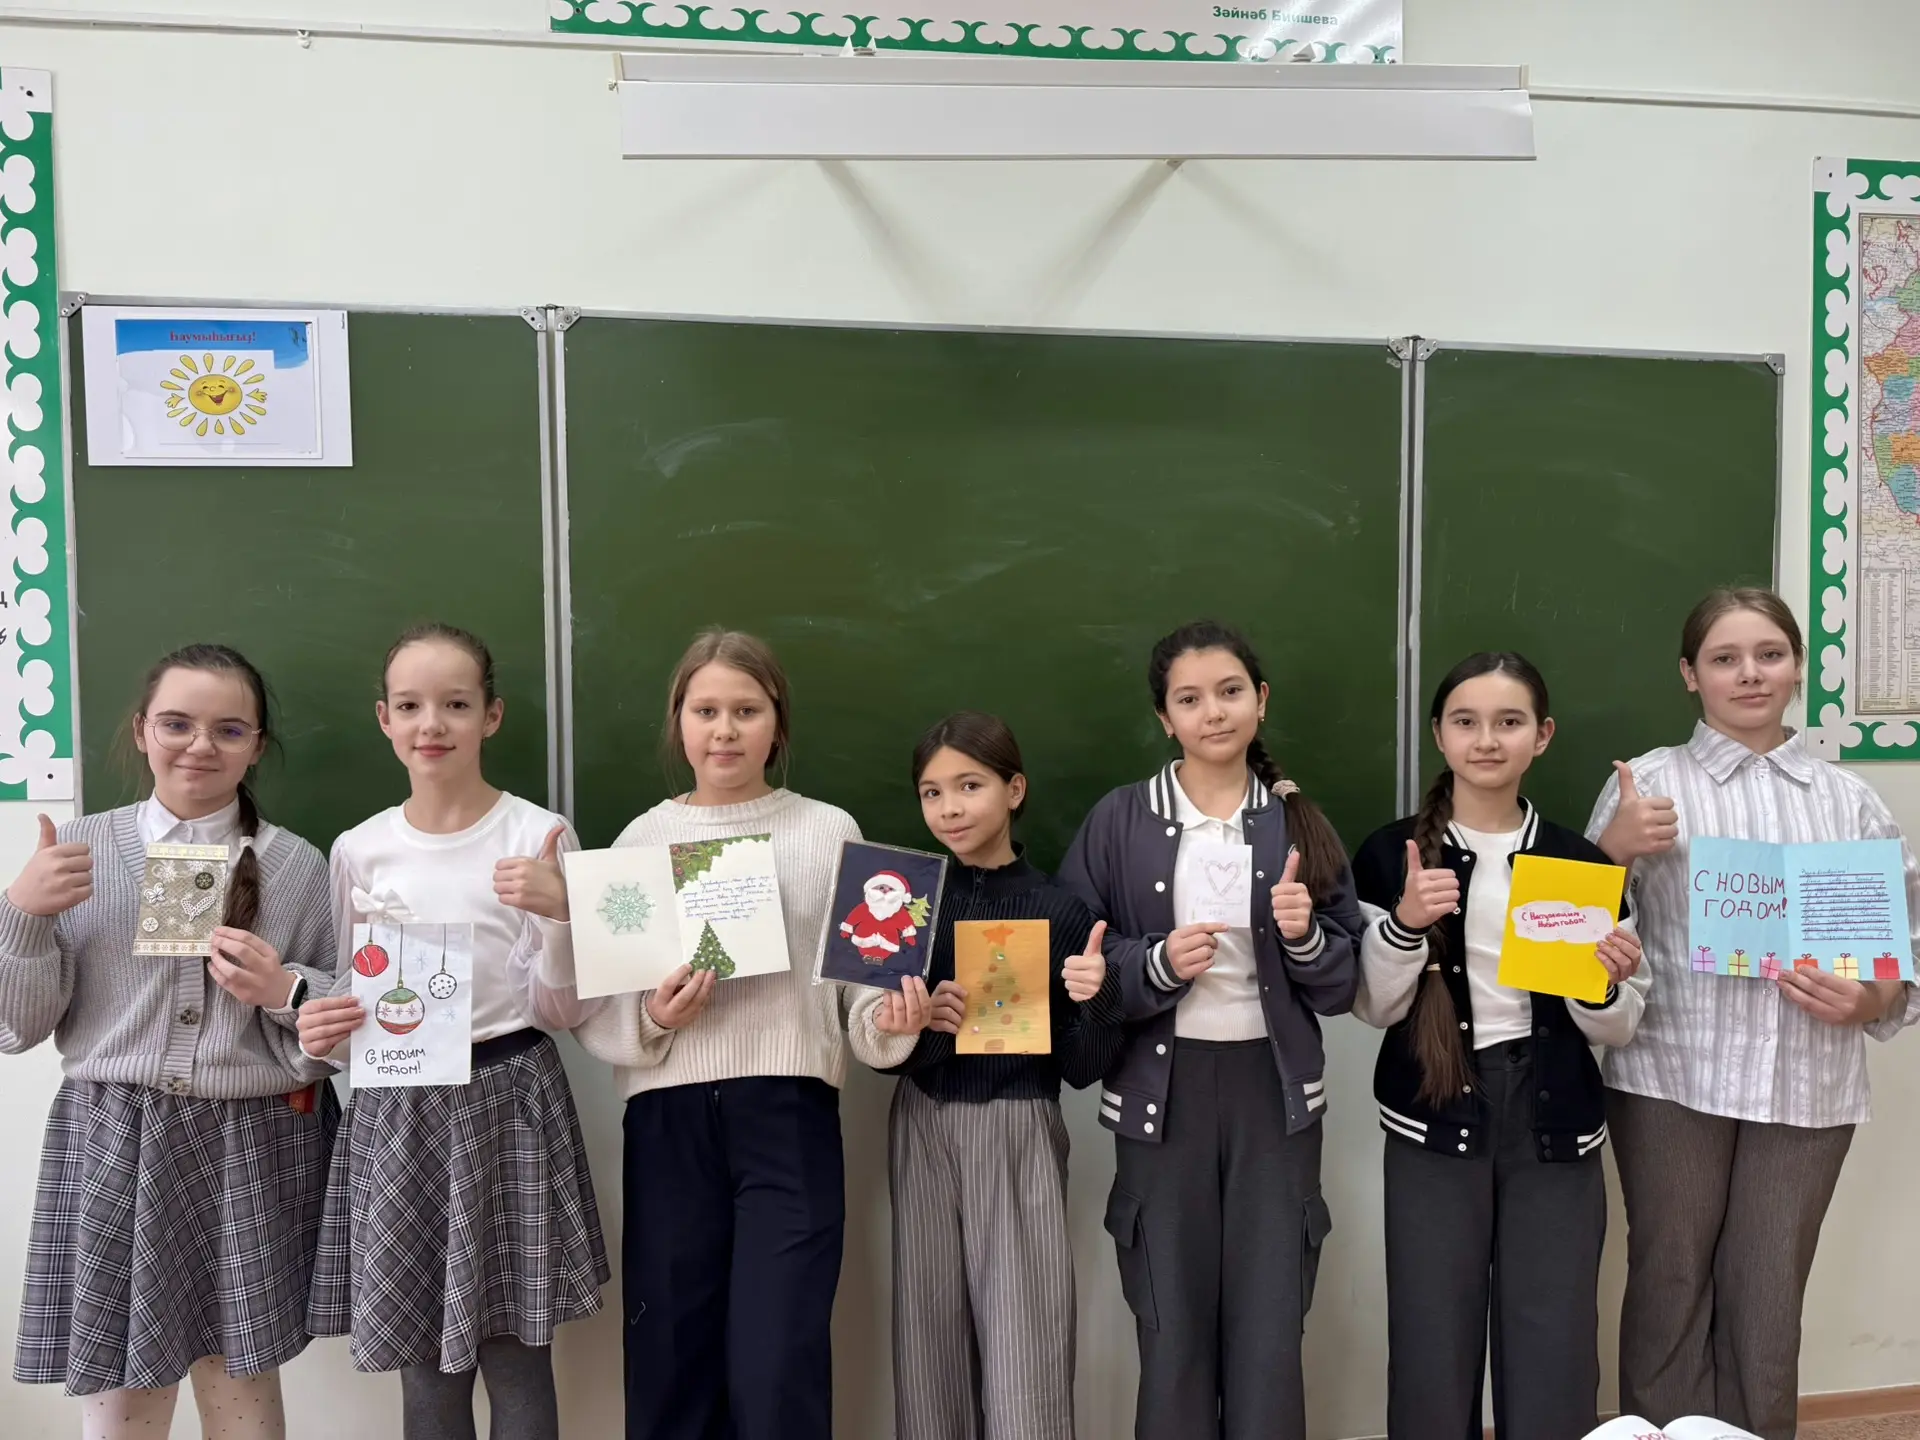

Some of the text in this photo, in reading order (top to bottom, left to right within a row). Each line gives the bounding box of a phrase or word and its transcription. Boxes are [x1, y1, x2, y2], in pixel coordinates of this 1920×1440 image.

[1212, 5, 1338, 25] Зәйнәб Биишева
[1716, 871, 1786, 895] НОВЫМ
[1704, 897, 1788, 920] ГОДОМ!
